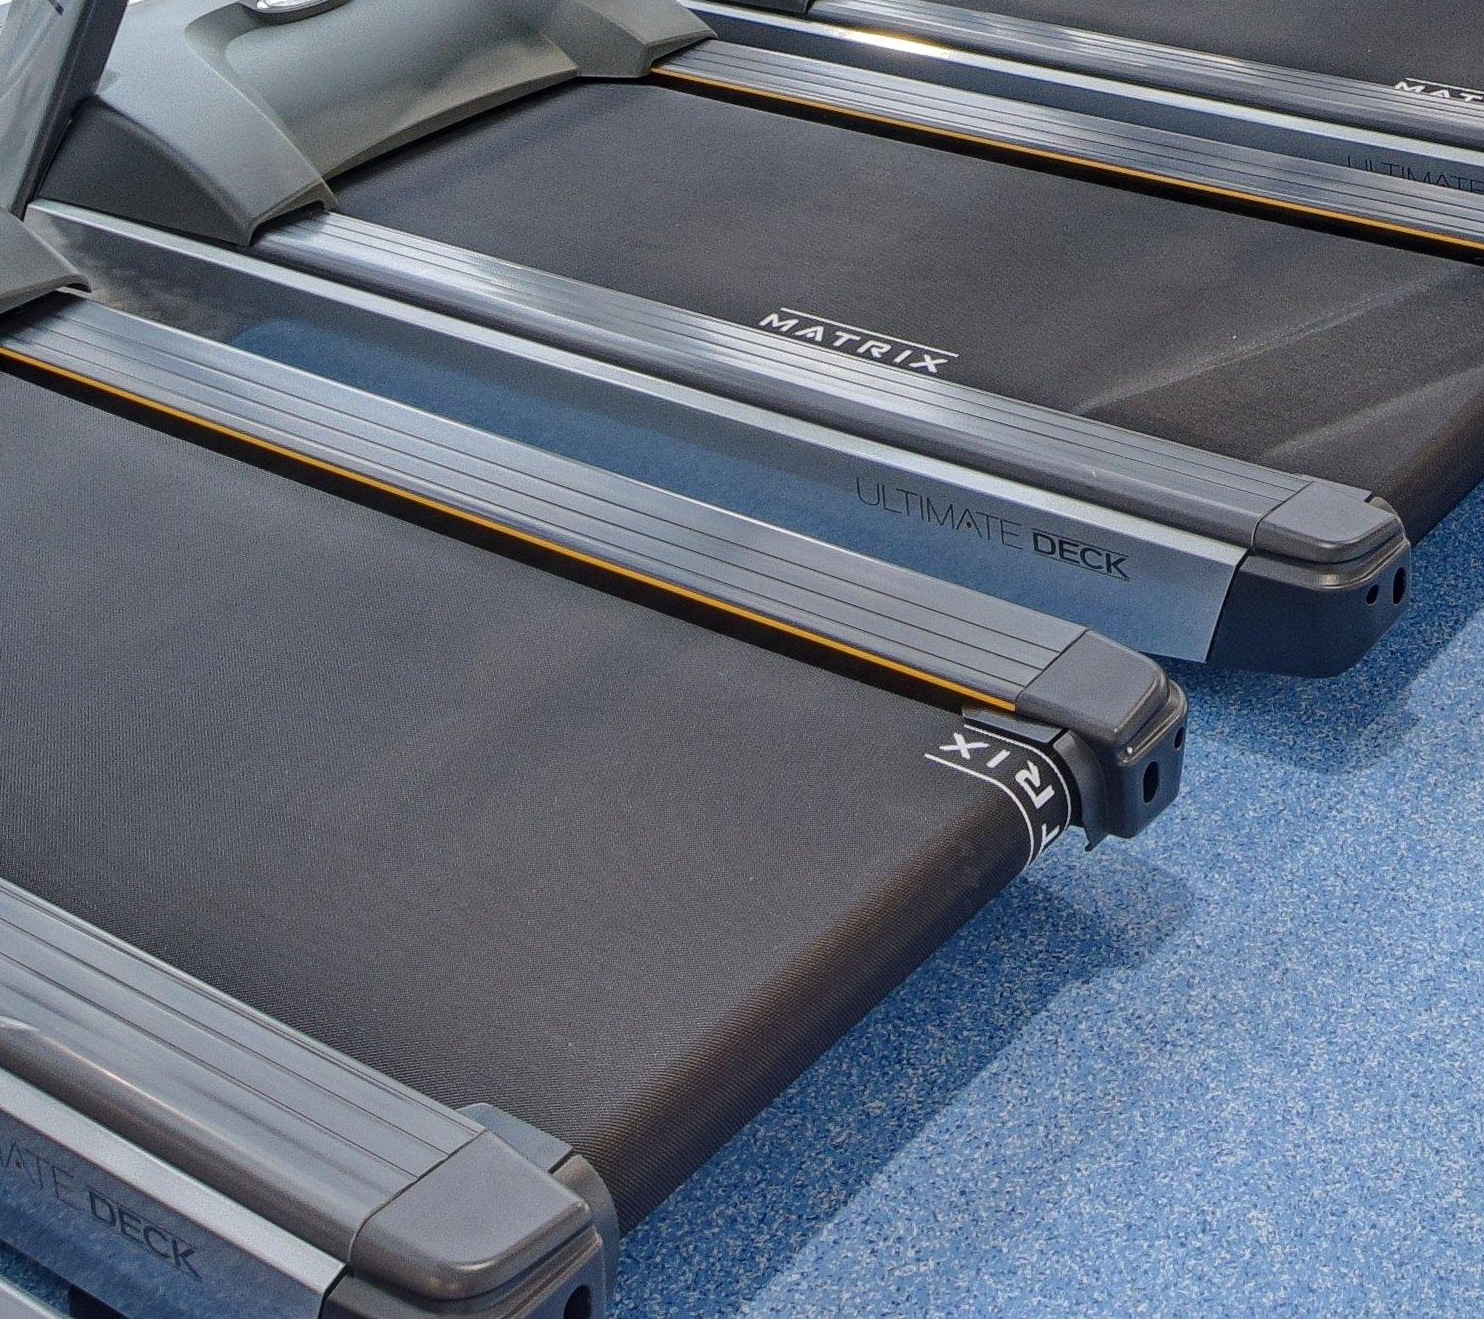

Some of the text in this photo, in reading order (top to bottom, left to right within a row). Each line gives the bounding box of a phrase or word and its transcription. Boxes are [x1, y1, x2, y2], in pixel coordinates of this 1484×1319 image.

[759, 312, 948, 376] MATRIX
[855, 475, 1130, 581] ULTIMATE DECK
[84, 1183, 204, 1281] DECK
